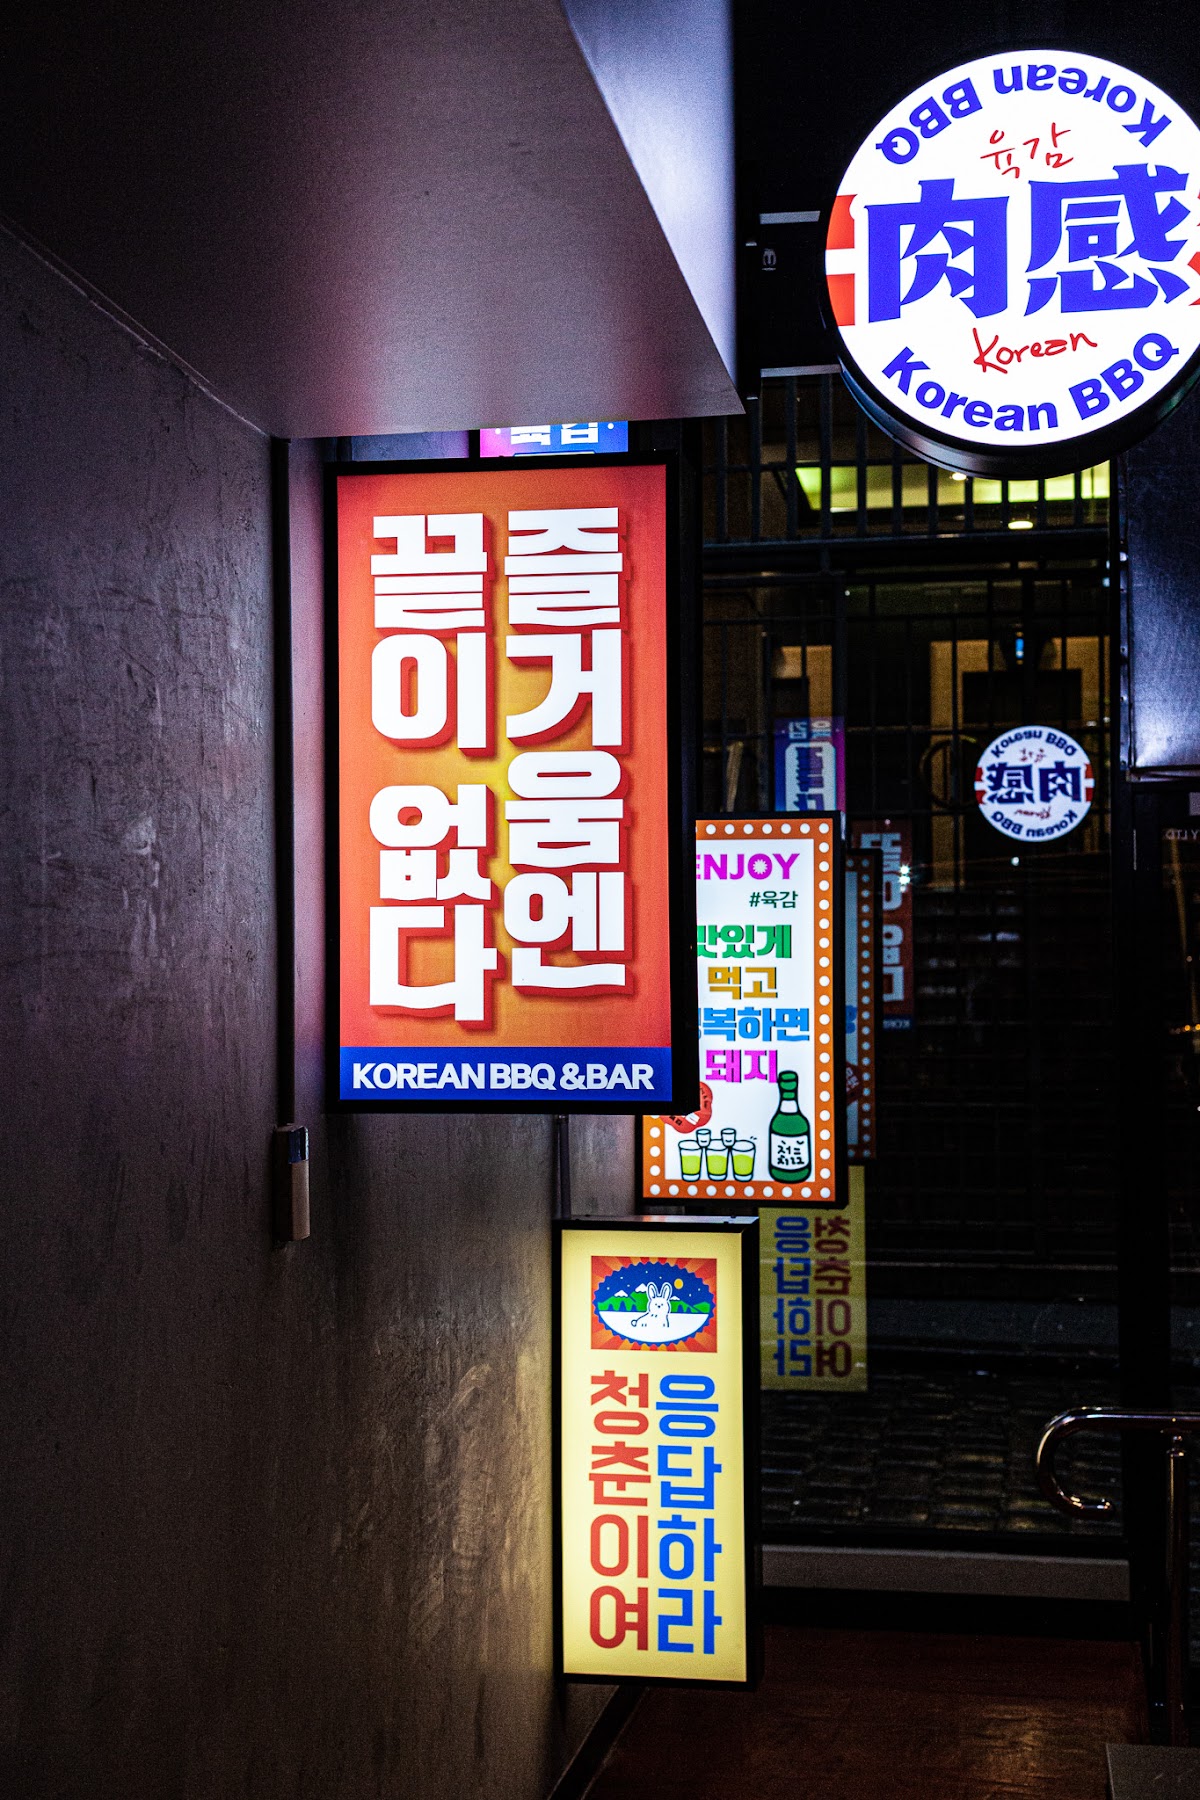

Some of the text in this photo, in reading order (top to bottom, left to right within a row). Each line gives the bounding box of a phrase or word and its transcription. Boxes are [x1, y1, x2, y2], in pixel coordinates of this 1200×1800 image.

[875, 64, 1172, 165] Korean BBQ
[980, 122, 1074, 178] 육감
[864, 163, 1191, 323] 肉感
[972, 327, 1098, 374] Korean
[882, 332, 1179, 431] Korean BBQ
[369, 512, 497, 1022] 끝이 없다
[504, 507, 627, 989] 즐거움엔
[696, 853, 800, 880] NJOY
[749, 890, 799, 909] #육감
[708, 966, 778, 1000] 먹고
[698, 1006, 810, 1042] 복하면
[352, 1062, 485, 1090] KOREAN
[490, 1062, 556, 1091] BBQ
[706, 1049, 779, 1083] 돼지
[588, 1370, 651, 1651] 청춘이여
[655, 1374, 722, 1655] 응답하라
